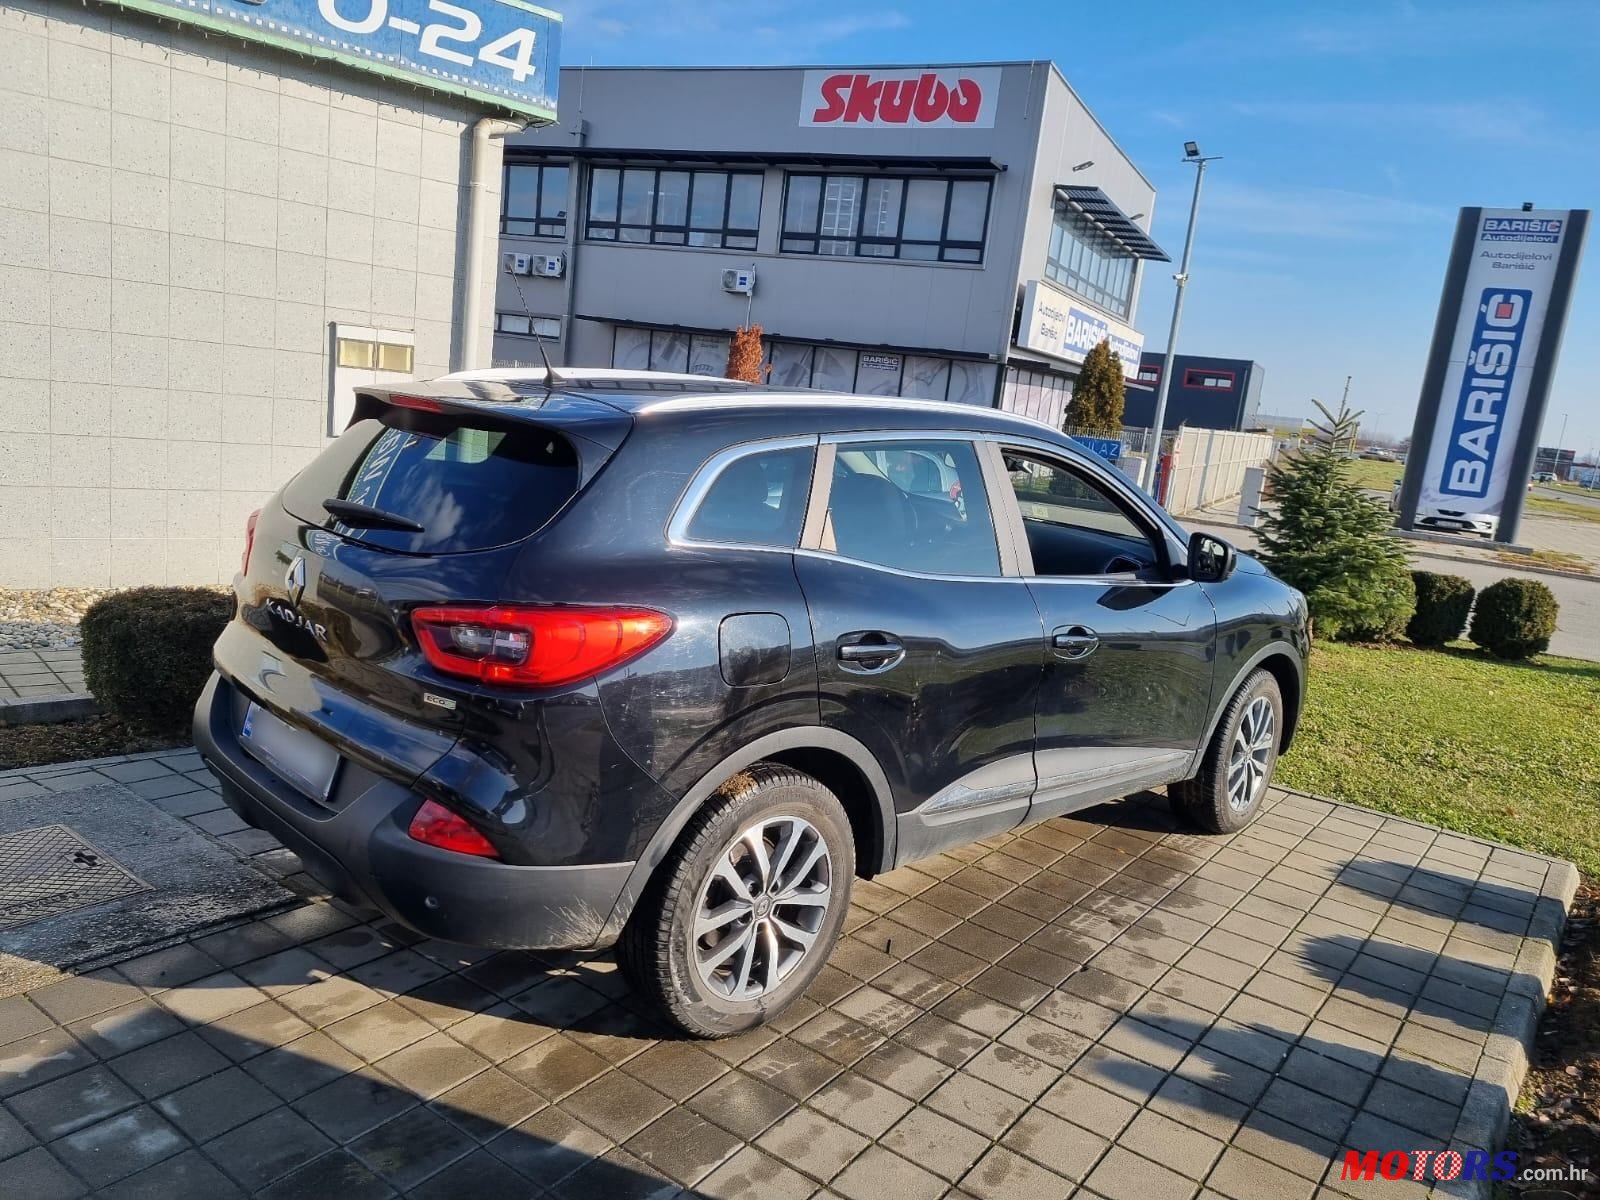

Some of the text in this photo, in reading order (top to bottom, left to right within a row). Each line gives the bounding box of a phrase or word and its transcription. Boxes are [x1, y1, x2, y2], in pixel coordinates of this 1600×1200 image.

[813, 73, 982, 123] Skuba
[1480, 250, 1552, 261] Autodijelovi
[1448, 294, 1526, 493] BARIŠIĆ
[266, 598, 328, 641] KADJAR
